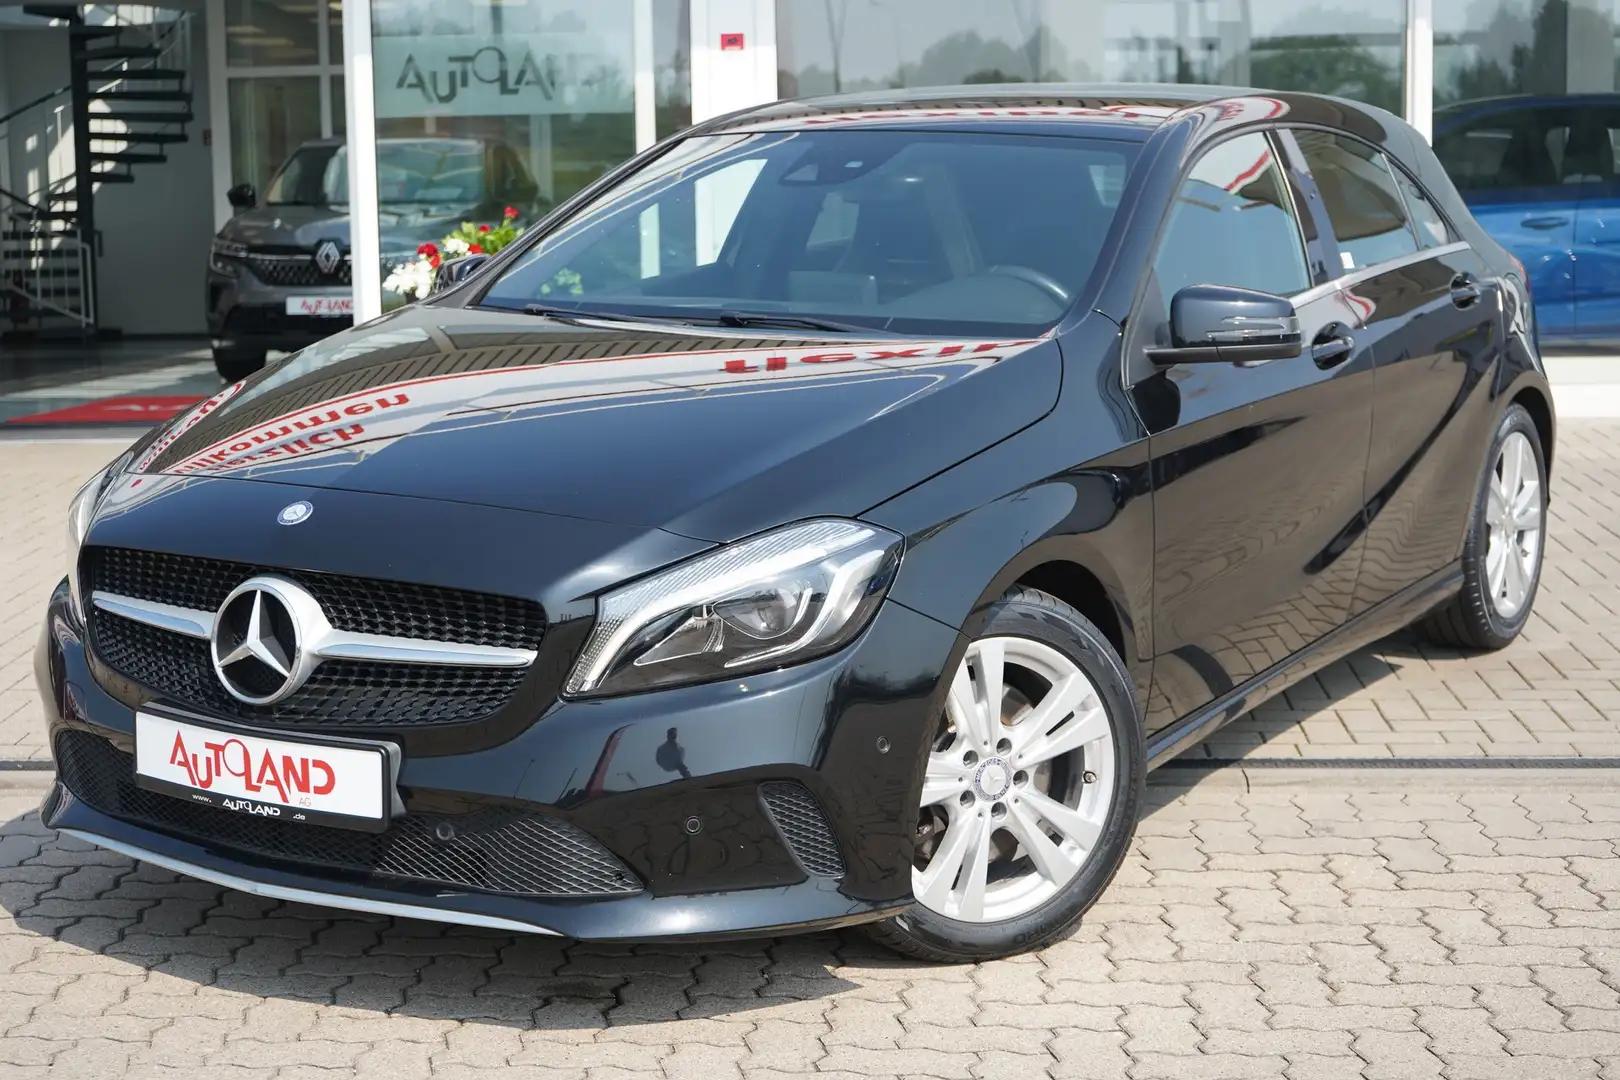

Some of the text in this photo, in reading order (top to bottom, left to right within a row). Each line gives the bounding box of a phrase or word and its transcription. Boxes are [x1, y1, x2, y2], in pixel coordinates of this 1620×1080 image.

[169, 729, 336, 804] AUTOLAND
[191, 793, 306, 821] www. AUTOLAND .de
[298, 797, 312, 808] AG
